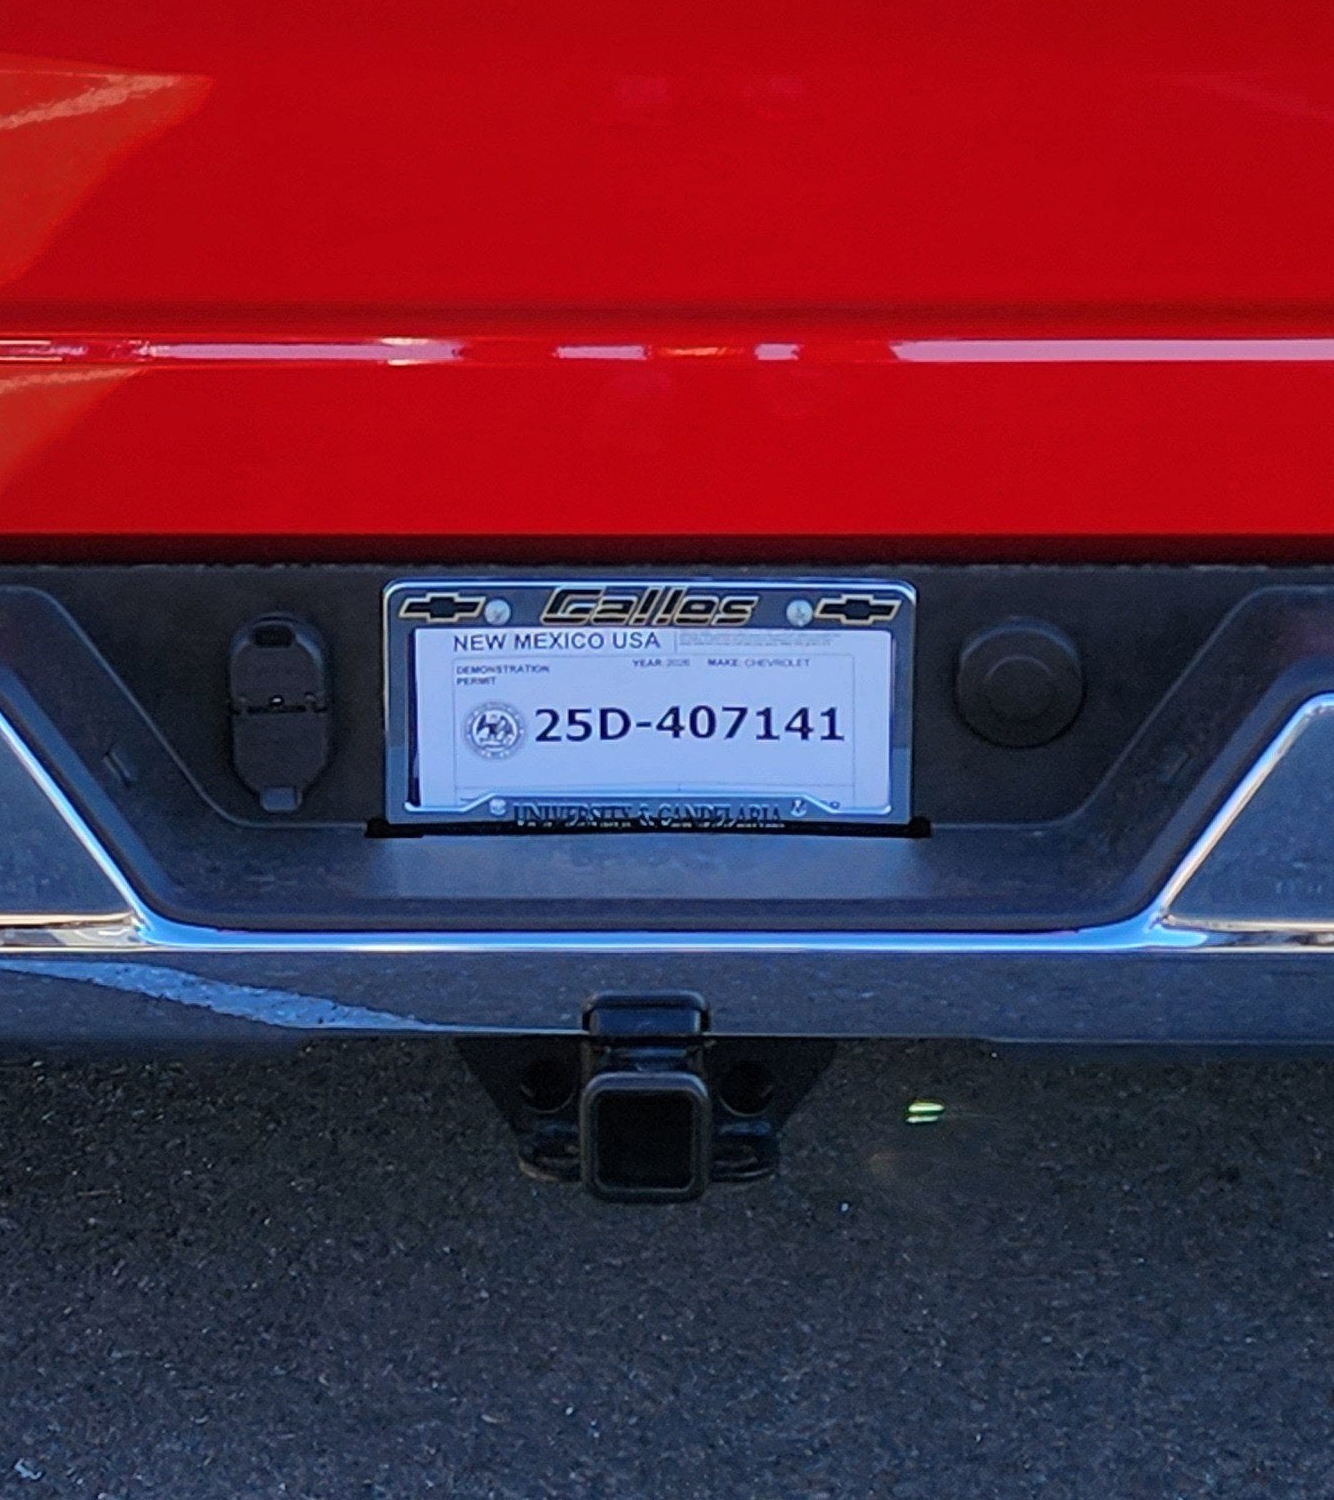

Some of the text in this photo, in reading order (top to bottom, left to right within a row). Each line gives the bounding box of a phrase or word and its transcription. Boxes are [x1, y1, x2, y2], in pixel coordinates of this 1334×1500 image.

[539, 585, 760, 627] Galles
[453, 633, 508, 652] NEW
[514, 631, 605, 651] MEXICO
[612, 630, 662, 649] USA
[456, 664, 550, 675] DEMONSTRATION
[744, 658, 811, 668] CHEVROLET
[456, 676, 496, 686] PERMIT
[534, 705, 845, 743] 25D-407141
[513, 802, 633, 828] UNIVERSITY
[657, 802, 786, 828] CANDELARIA
